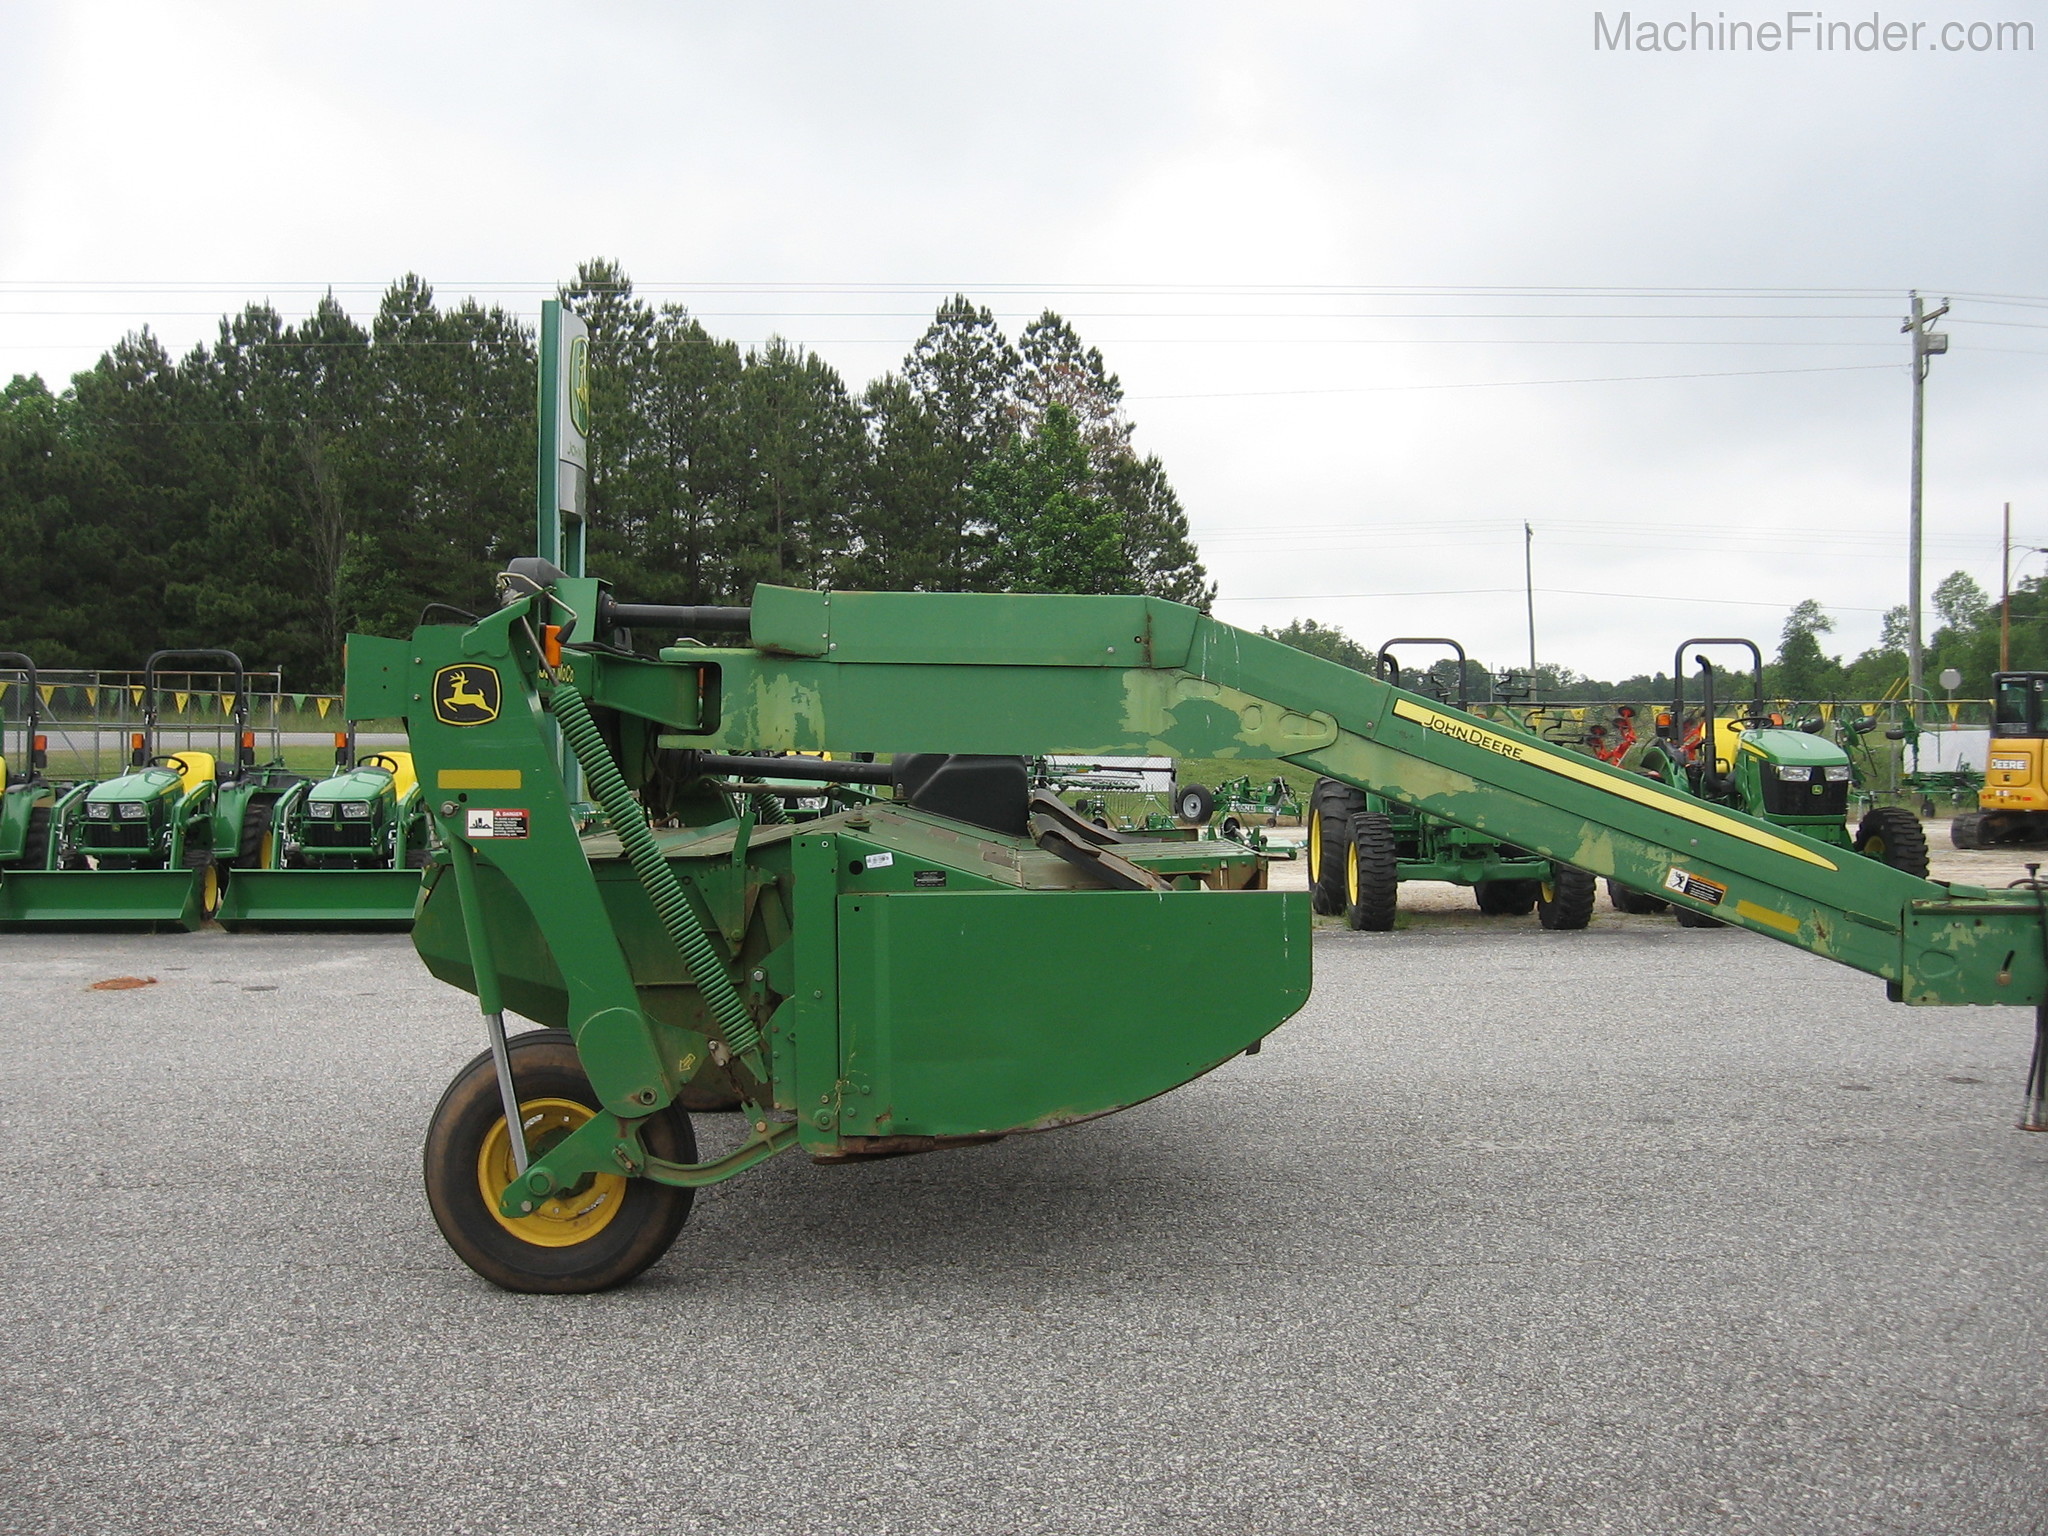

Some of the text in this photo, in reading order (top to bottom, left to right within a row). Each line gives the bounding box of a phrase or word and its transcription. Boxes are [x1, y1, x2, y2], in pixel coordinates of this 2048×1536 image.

[1424, 715, 1523, 759] JOHN DEERE
[1991, 759, 2026, 770] DEERE
